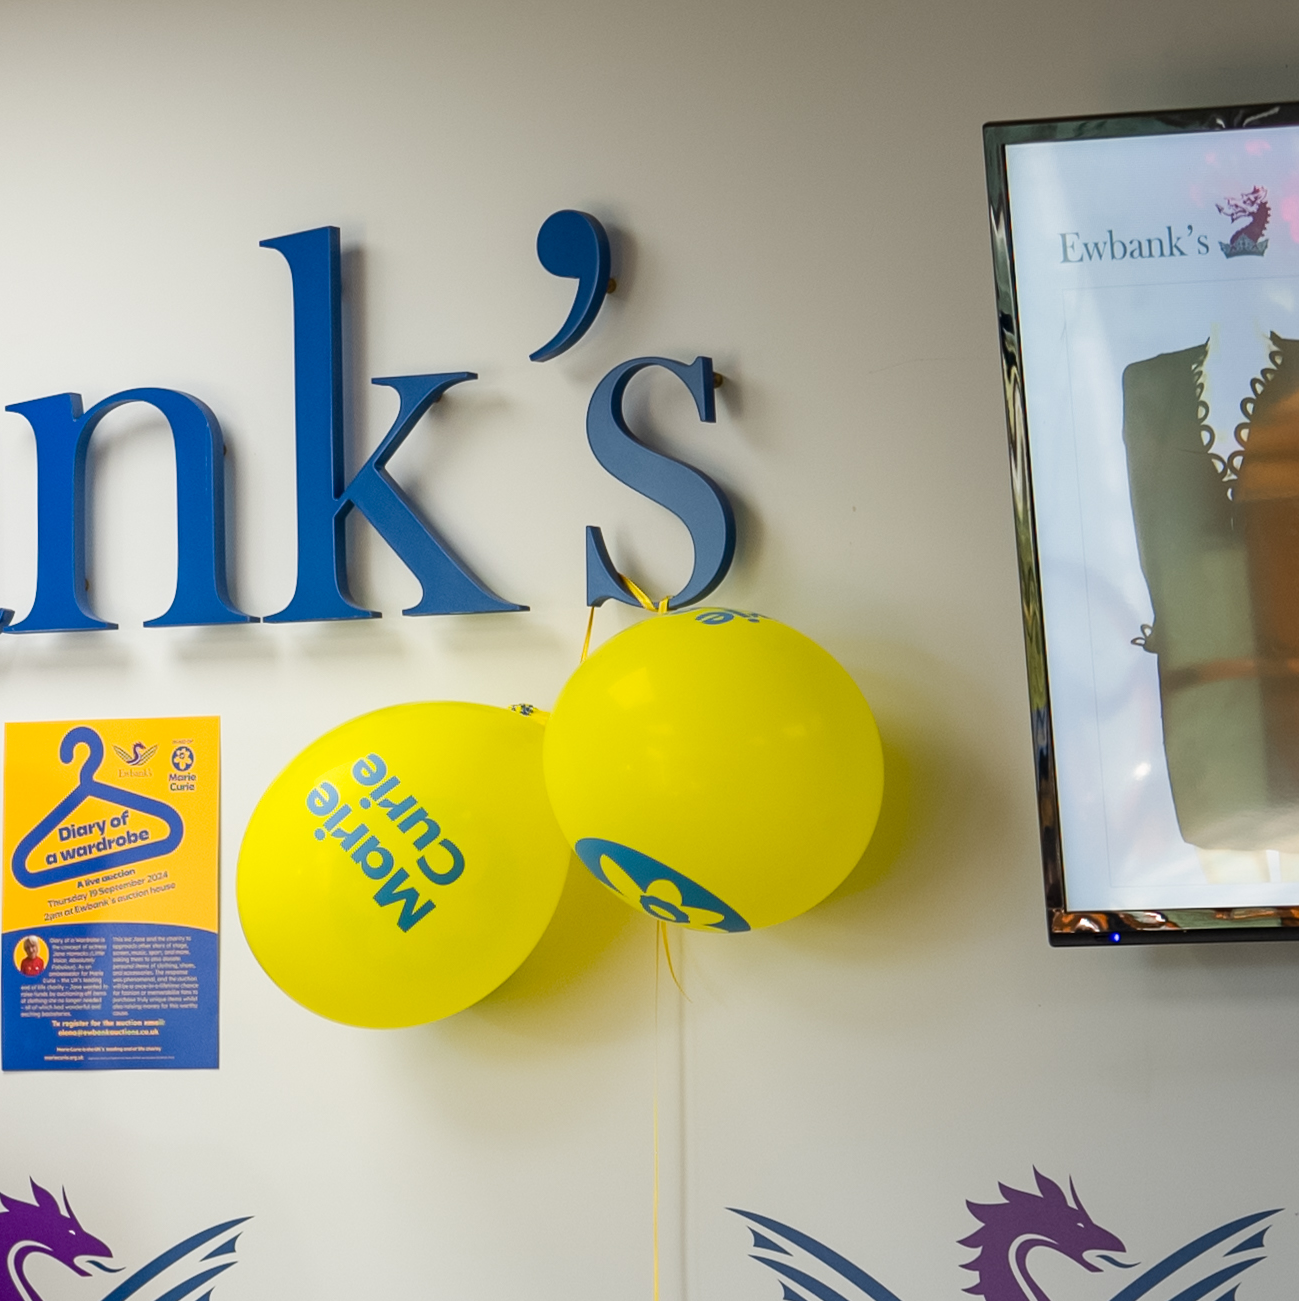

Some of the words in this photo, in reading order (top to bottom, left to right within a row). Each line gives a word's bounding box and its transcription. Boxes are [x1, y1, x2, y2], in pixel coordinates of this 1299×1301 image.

[1060, 224, 1210, 264] Ewbank's
[169, 772, 196, 781] Marie
[170, 782, 195, 791] Curie
[58, 820, 106, 841] Diary
[110, 810, 129, 828] of
[352, 752, 466, 886] Curie
[45, 852, 58, 865] a
[60, 830, 149, 861] wardrobe
[306, 781, 437, 933] Marie
[47, 894, 87, 907] Thursday
[98, 878, 145, 895] September
[85, 877, 100, 887] live
